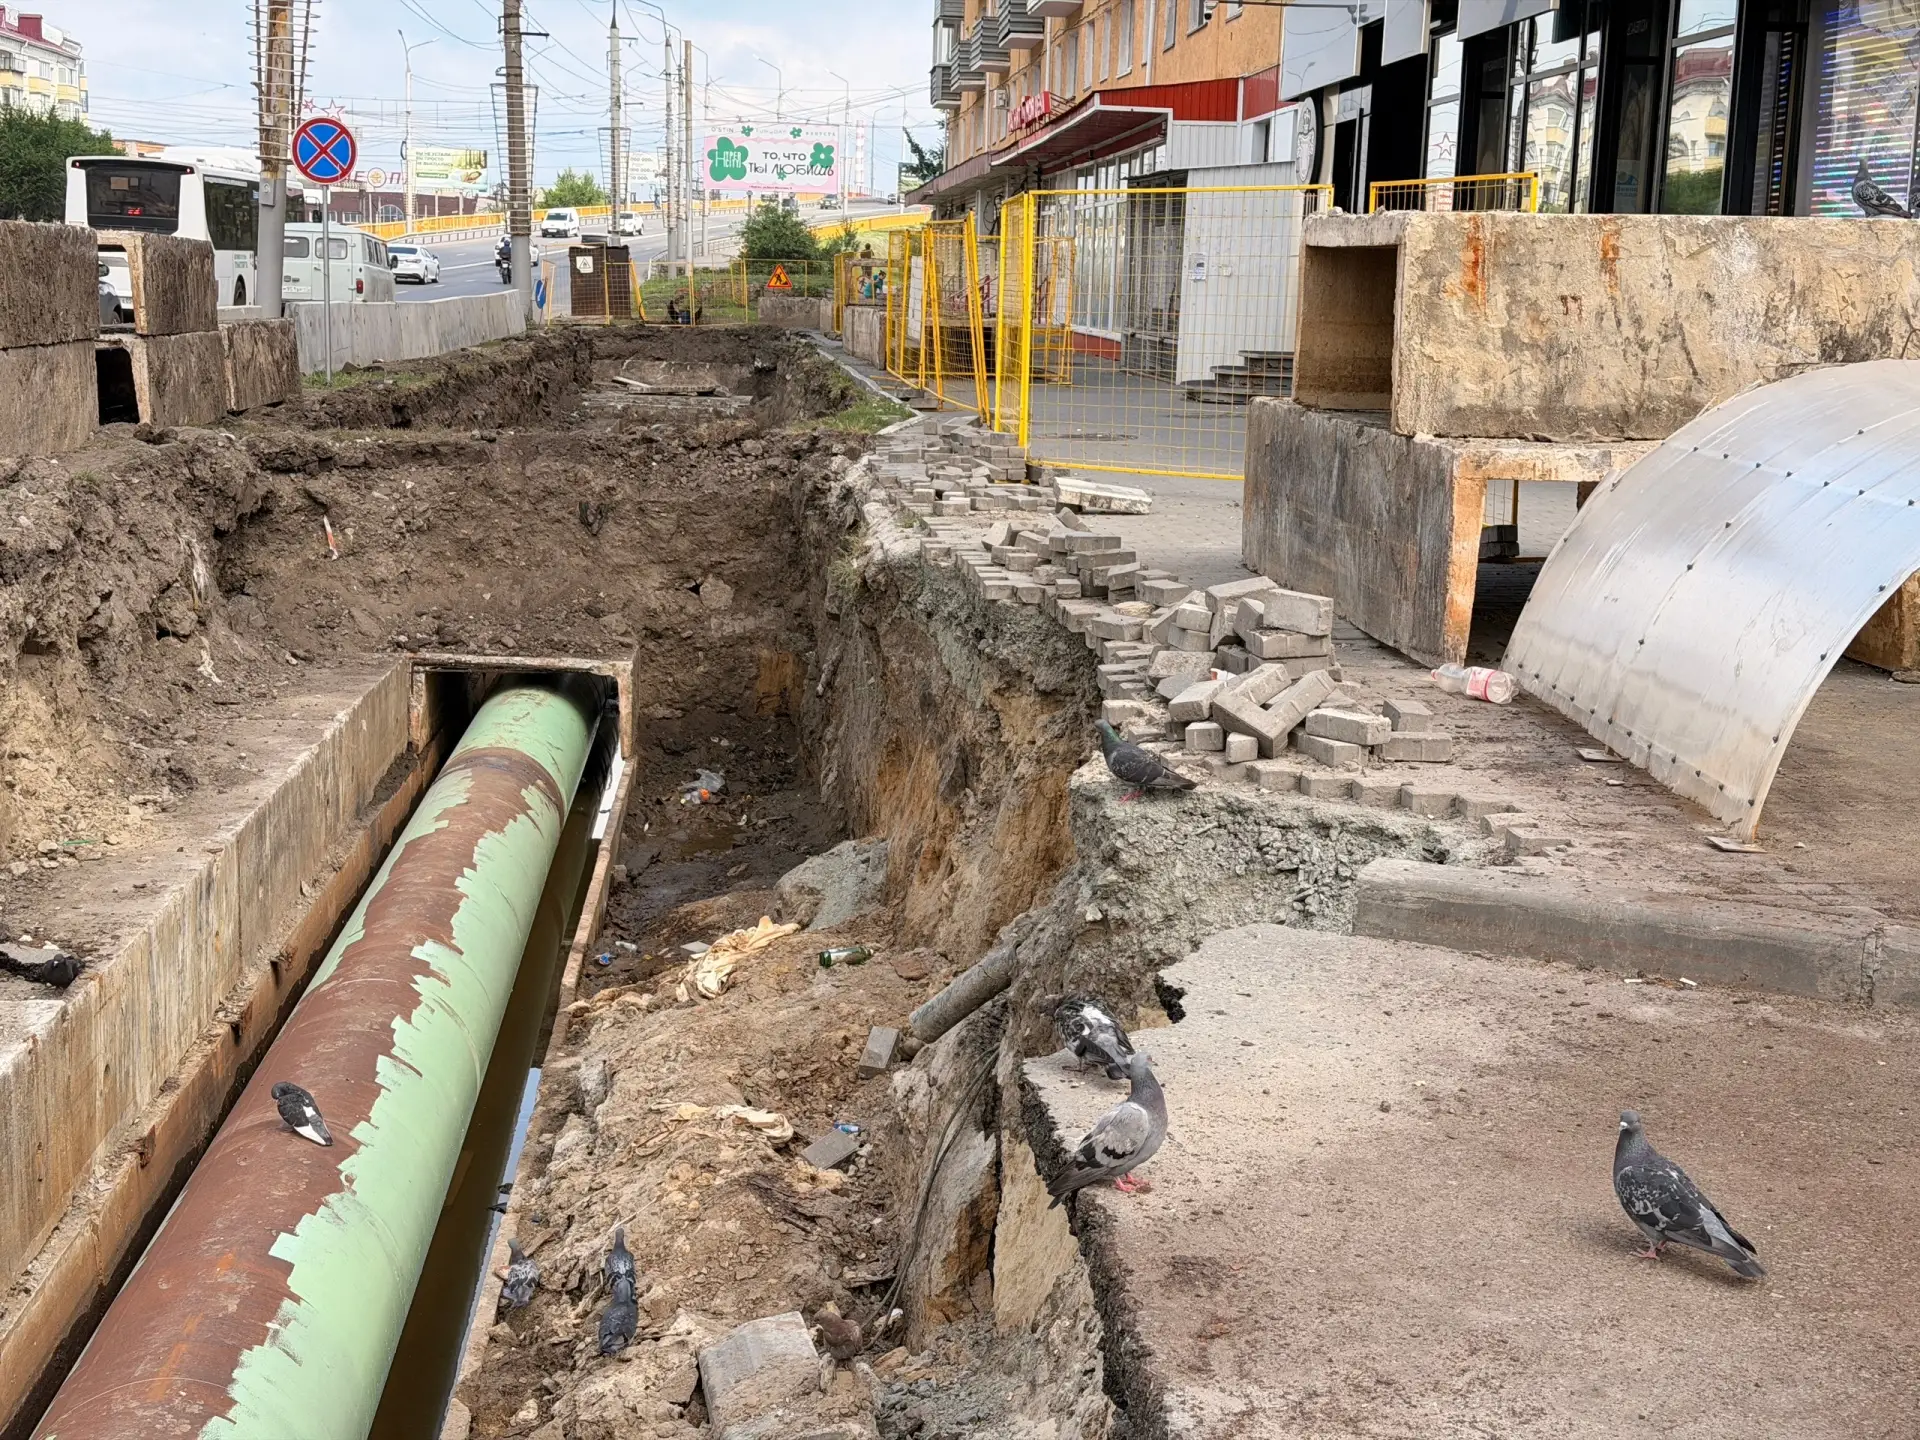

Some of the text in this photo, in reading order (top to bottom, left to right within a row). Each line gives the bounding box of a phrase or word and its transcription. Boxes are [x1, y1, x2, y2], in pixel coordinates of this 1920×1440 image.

[763, 151, 807, 161] ТО, ЧТО
[748, 162, 834, 176] ТЫ ЛЮБИШЬ
